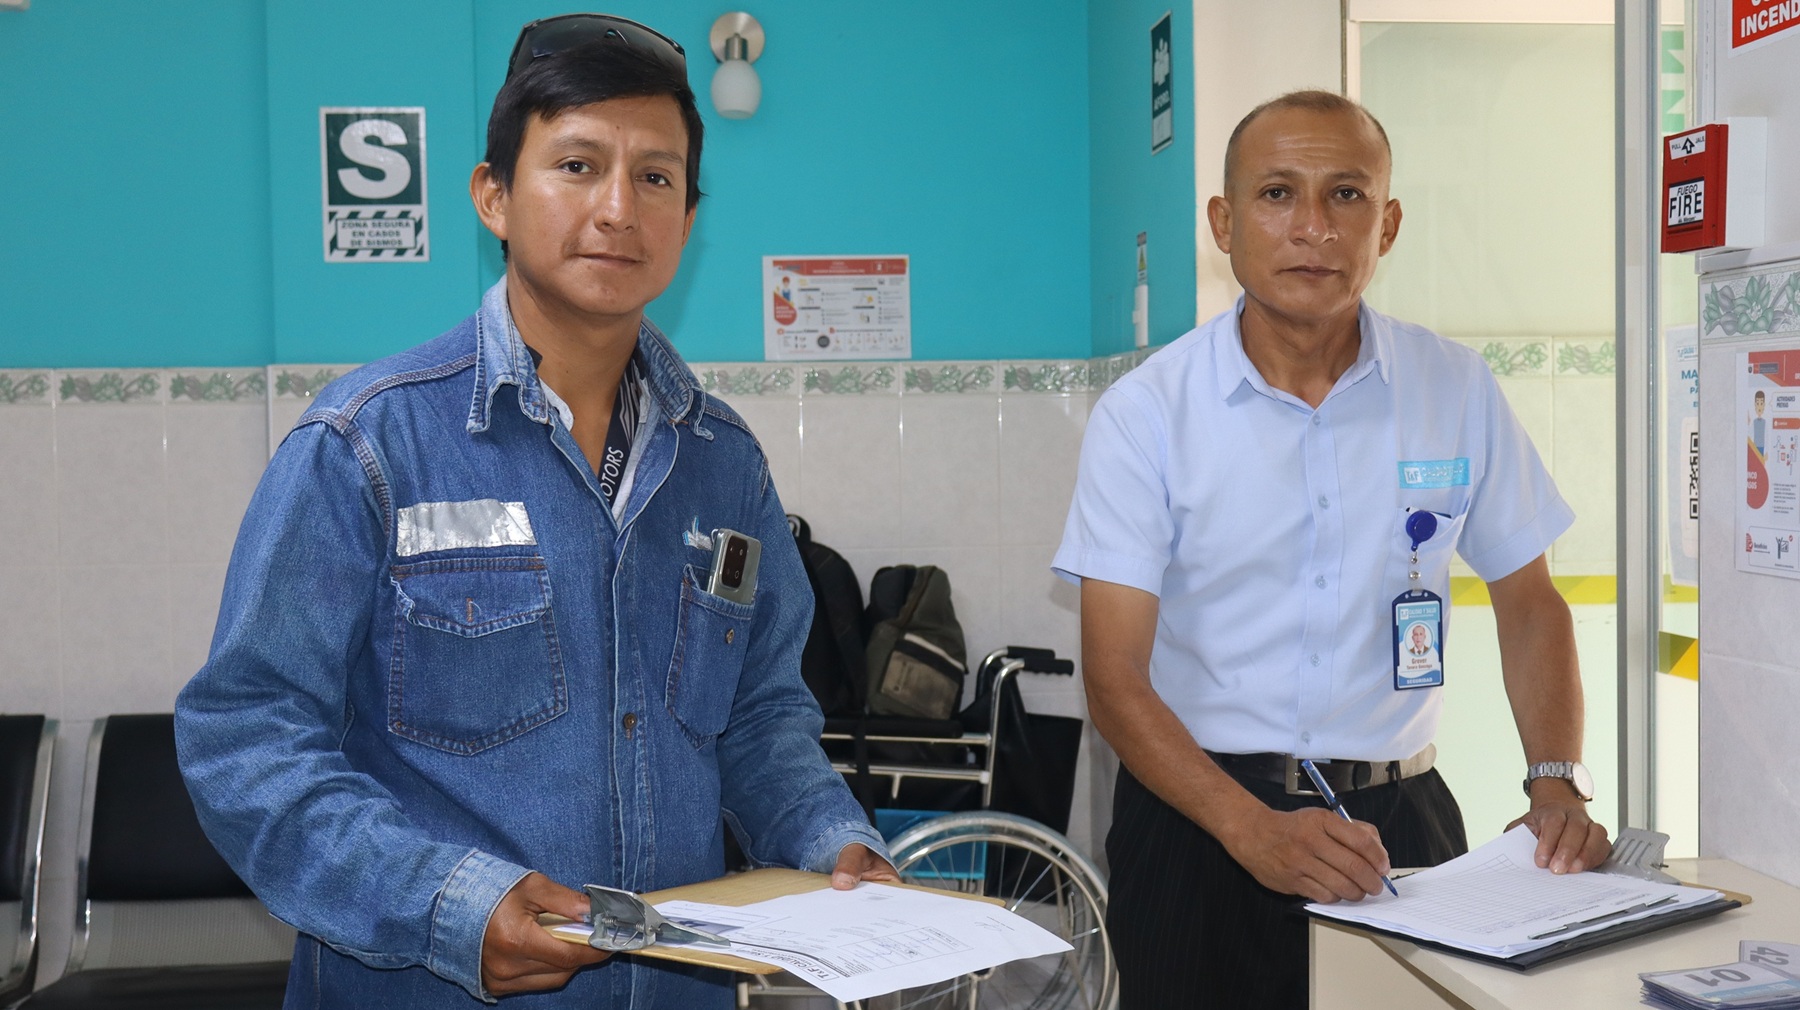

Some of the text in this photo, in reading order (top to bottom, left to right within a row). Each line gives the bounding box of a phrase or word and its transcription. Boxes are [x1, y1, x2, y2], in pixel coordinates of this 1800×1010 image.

[337, 119, 412, 199] S
[1677, 184, 1698, 196] FUEGO
[1669, 192, 1702, 219] FIRE
[599, 446, 624, 501] OTORS
[807, 966, 830, 979] T&F
[1684, 968, 1751, 987] 01
